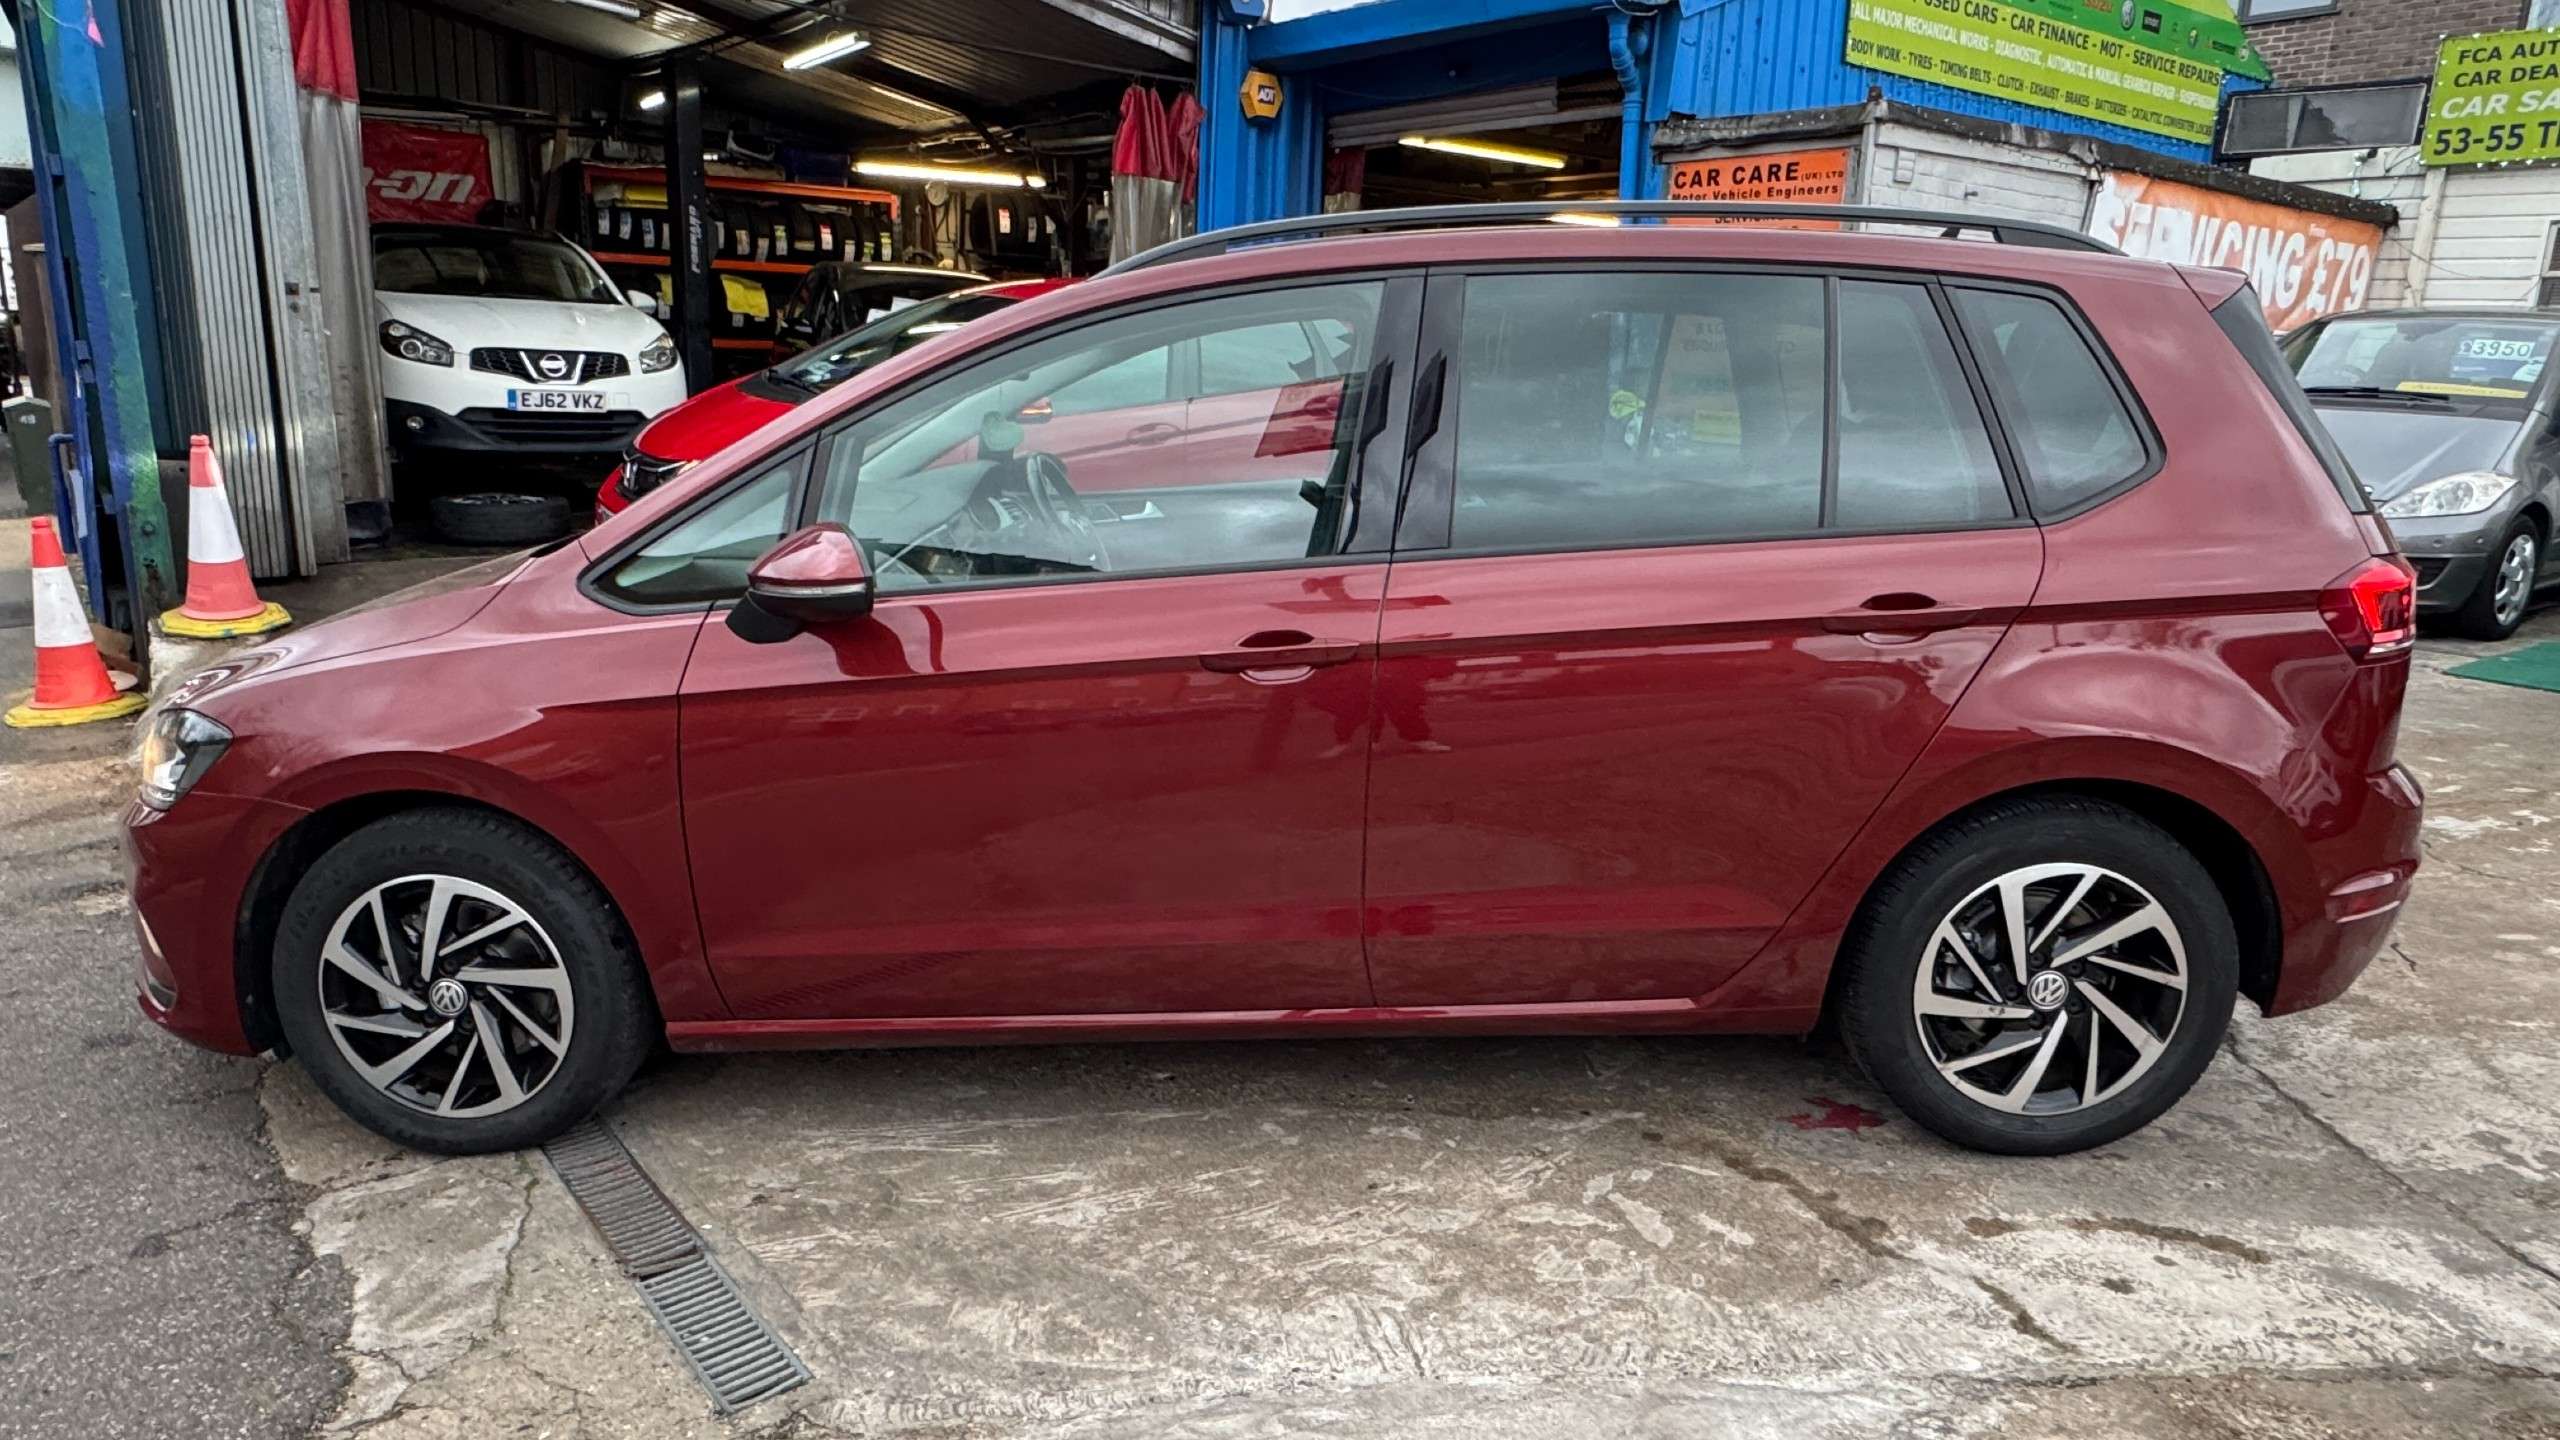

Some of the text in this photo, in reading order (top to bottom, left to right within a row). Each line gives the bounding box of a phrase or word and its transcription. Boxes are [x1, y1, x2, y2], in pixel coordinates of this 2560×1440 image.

[1873, 7, 1903, 29] MAJOR
[1904, 14, 1958, 44] MECHANICAL
[1959, 29, 1990, 52] WORKS
[1964, 0, 1998, 24] CARS
[2010, 13, 2035, 34] CAR
[2038, 21, 2090, 50] FINANCE
[2099, 39, 2123, 59] MOT
[2132, 49, 2177, 74] SERVICE
[2178, 62, 2220, 86] REPAIRS
[2457, 40, 2560, 65] FCA AUT
[1850, 38, 1874, 55] BODY
[1876, 43, 1902, 62] WORK
[1908, 51, 1933, 70] TYRES
[1940, 59, 1968, 78] TIMING
[1969, 65, 1991, 84] BELTS
[1997, 74, 2024, 91] CLUTCH
[2030, 81, 2060, 101] EXHAUST
[2064, 90, 2090, 108] BRAKES
[2453, 63, 2559, 88] CAR DEA
[1257, 86, 1274, 103] ADT
[2440, 87, 2560, 119] CAR SA
[2432, 123, 2526, 156] 53-55
[1674, 162, 1844, 190] CAR CARE (UK) LTD
[1712, 188, 1761, 201] Vehicle
[1767, 184, 1839, 199] Engineers
[2307, 237, 2372, 313] £79
[2458, 339, 2530, 357] £3950
[521, 392, 567, 409] EJ62
[571, 393, 604, 410] VKZ
